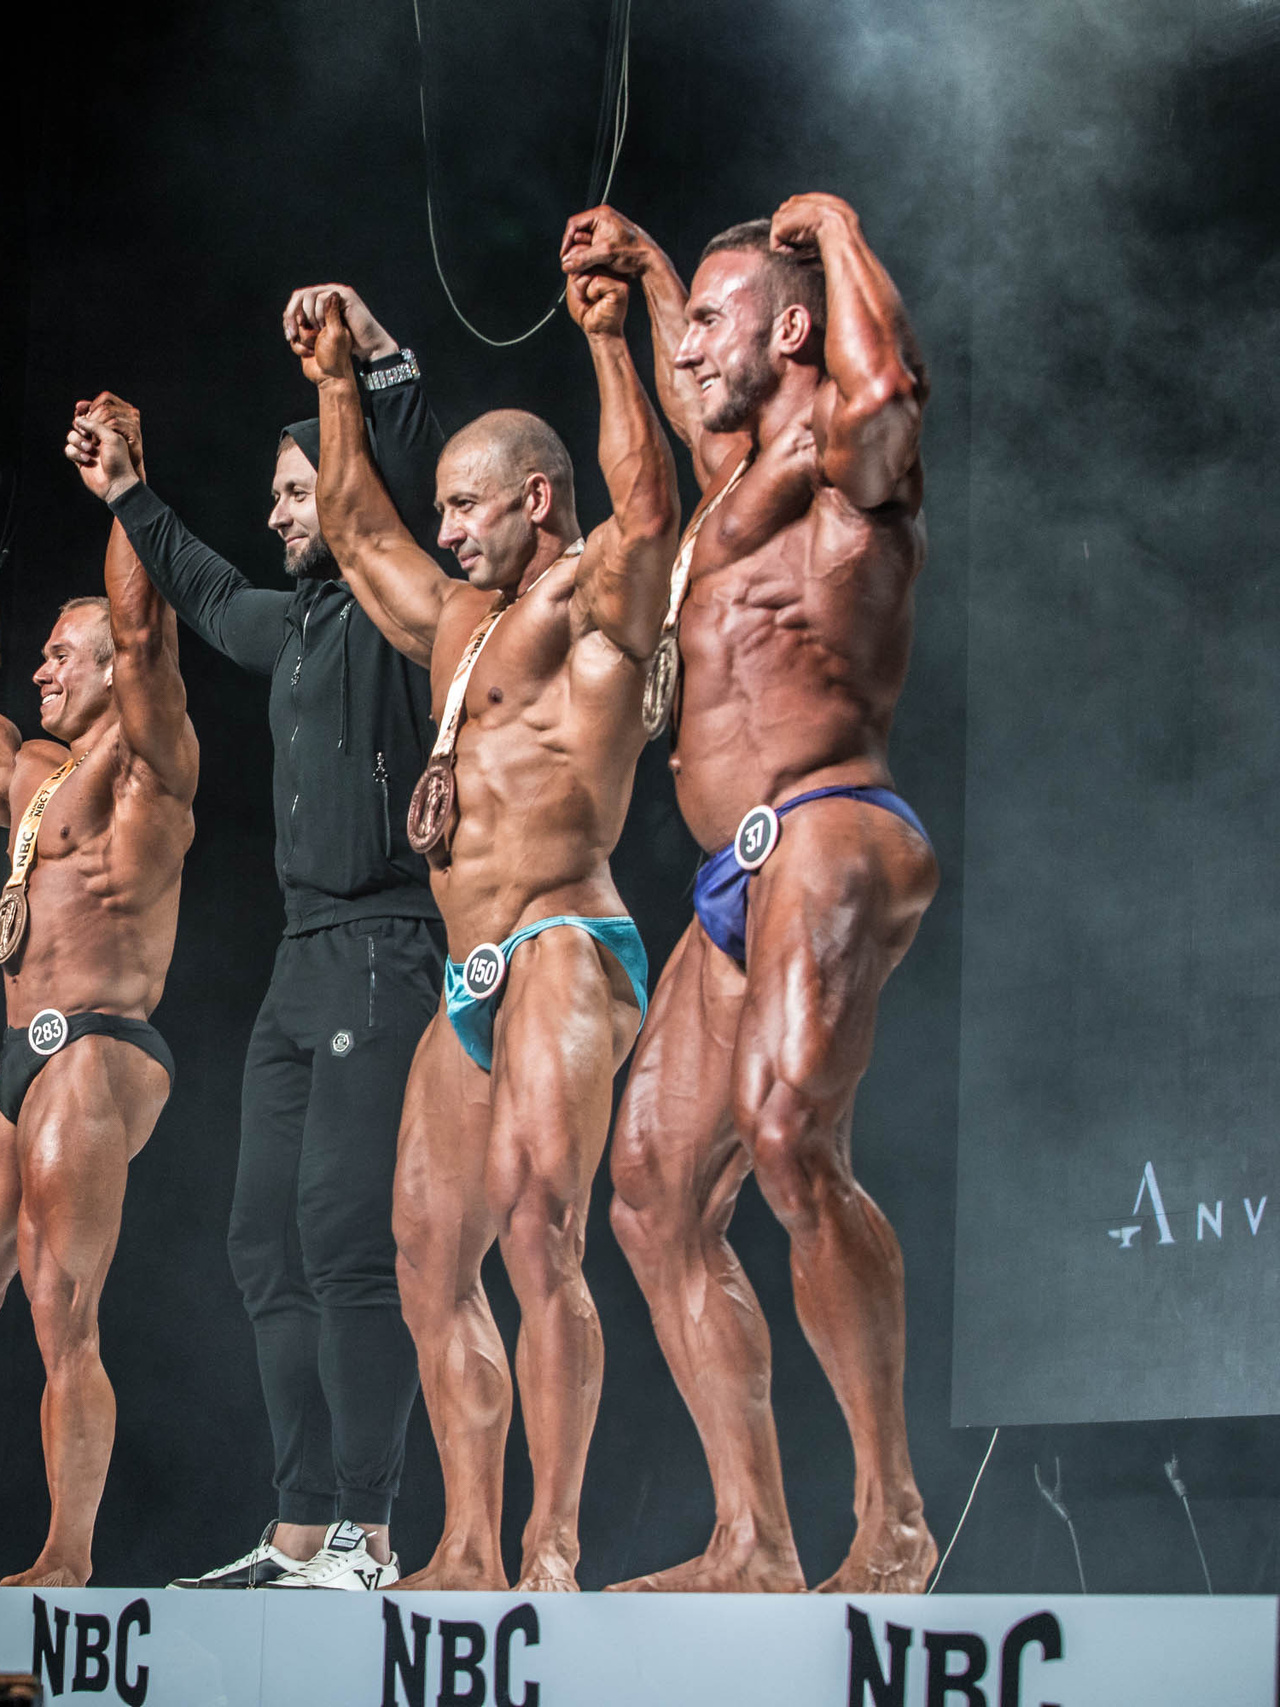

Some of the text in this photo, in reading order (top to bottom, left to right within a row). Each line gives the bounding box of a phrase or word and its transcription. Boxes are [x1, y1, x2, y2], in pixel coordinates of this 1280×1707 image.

[34, 797, 48, 817] NBC
[17, 832, 35, 867] NBC
[745, 819, 764, 853] 37
[469, 958, 497, 985] 150
[33, 1018, 62, 1046] 283
[32, 1594, 151, 1707] NBC
[381, 1597, 540, 1707] NBC
[847, 1604, 1064, 1707] NBC
